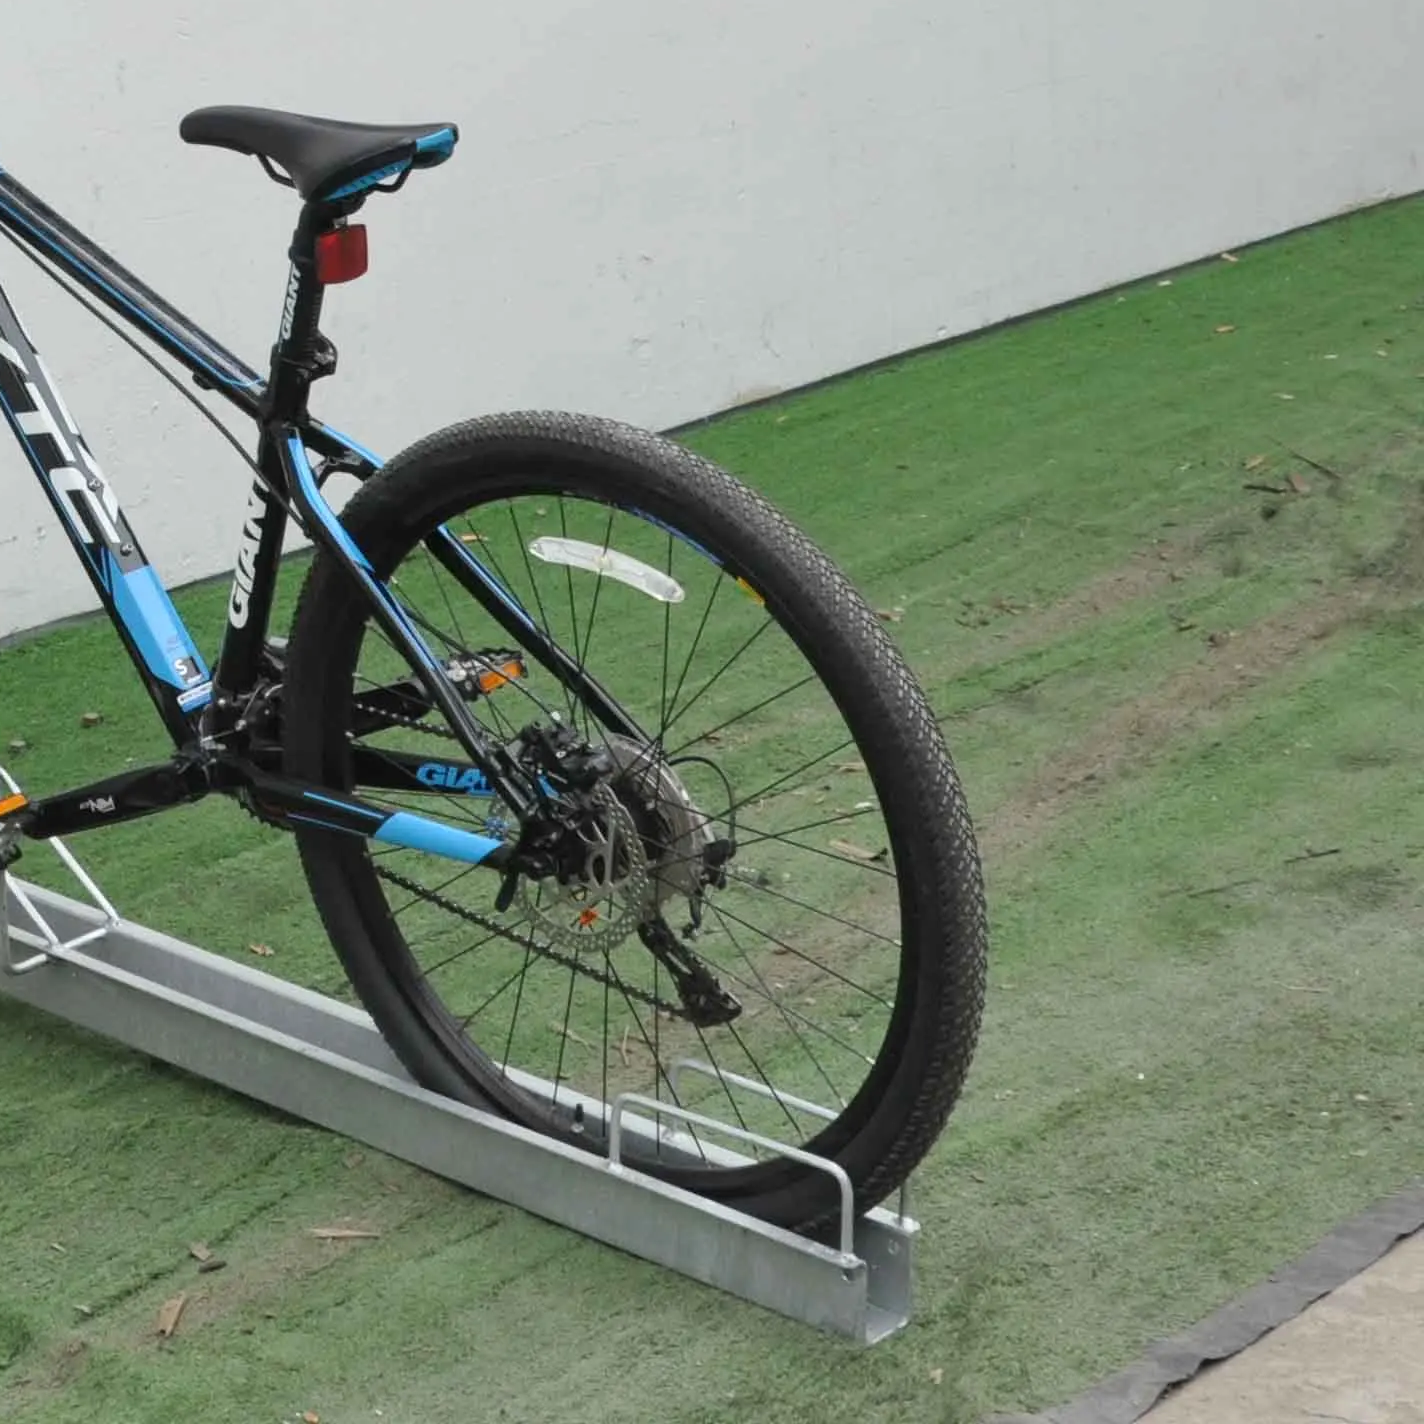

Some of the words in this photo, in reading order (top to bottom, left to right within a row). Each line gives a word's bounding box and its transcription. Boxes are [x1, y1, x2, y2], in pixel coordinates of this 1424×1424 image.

[279, 263, 301, 341] GIANT
[229, 472, 270, 630] GIANT
[415, 762, 488, 791] GIA
